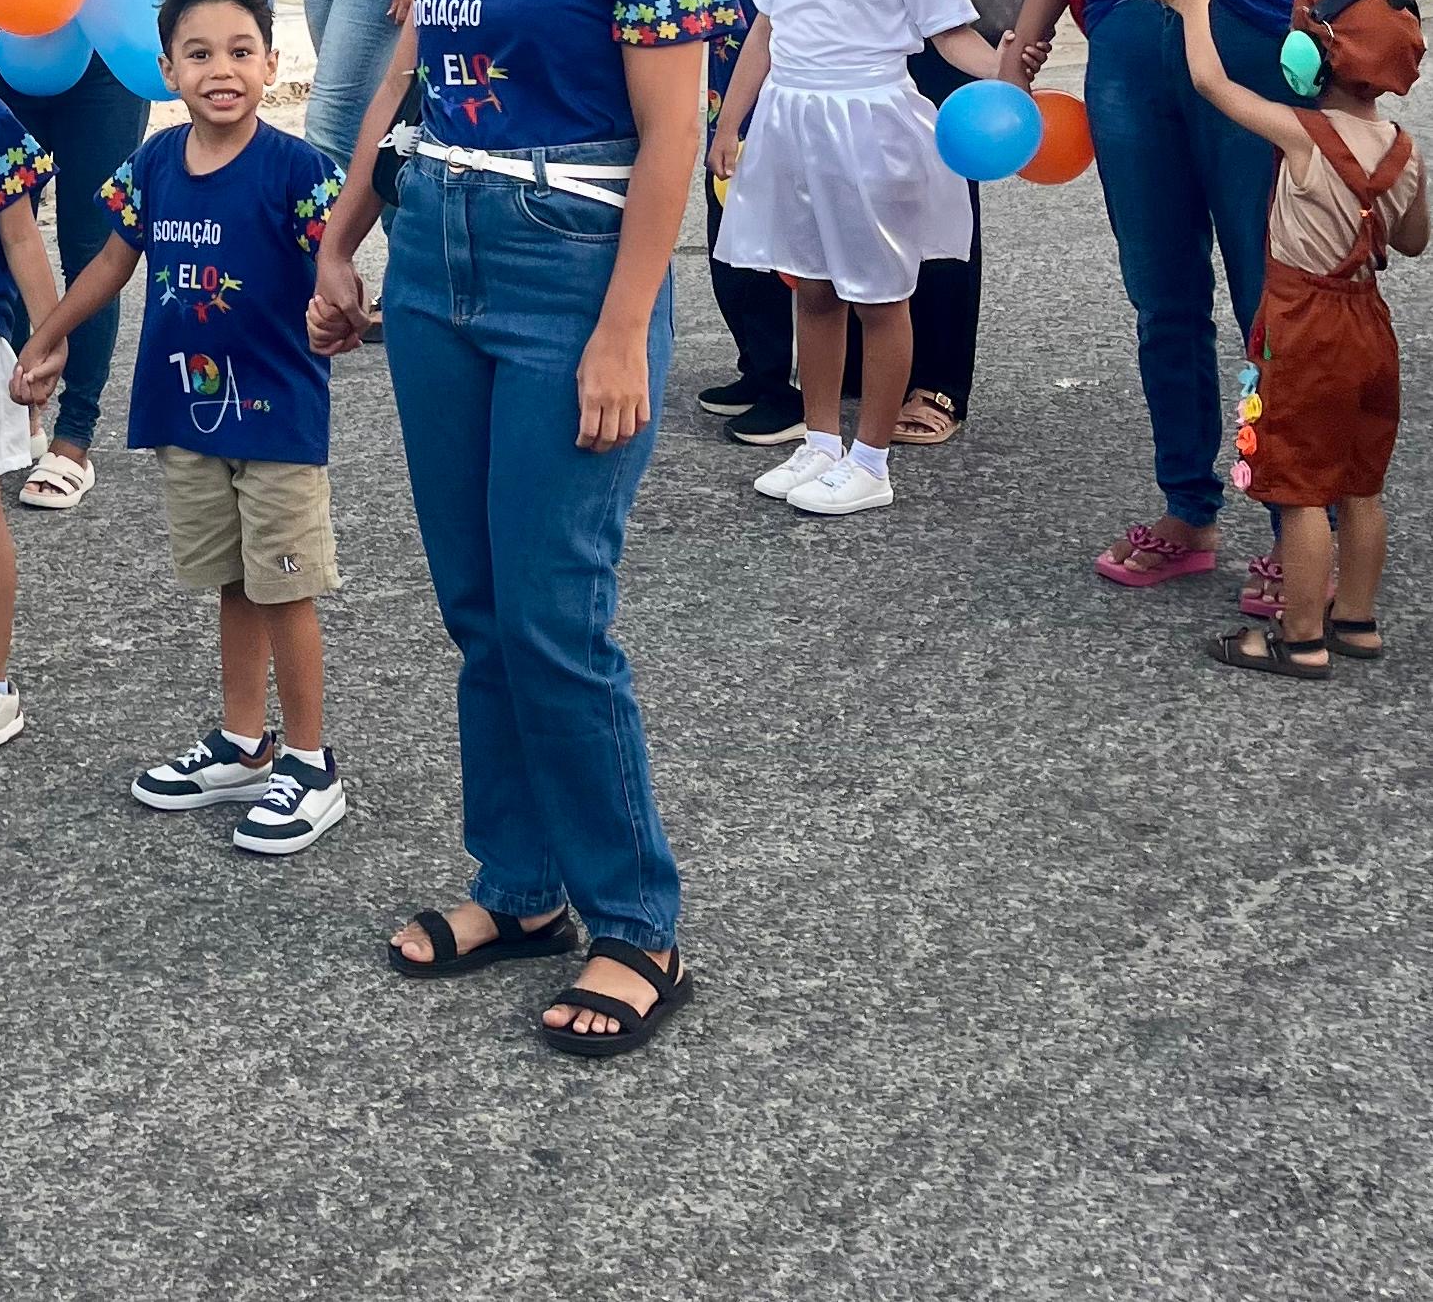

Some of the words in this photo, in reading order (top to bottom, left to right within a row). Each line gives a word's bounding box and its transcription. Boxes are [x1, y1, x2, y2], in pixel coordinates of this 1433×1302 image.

[443, 54, 492, 86] ELO
[178, 263, 219, 292] ELO
[169, 351, 221, 395] 10
